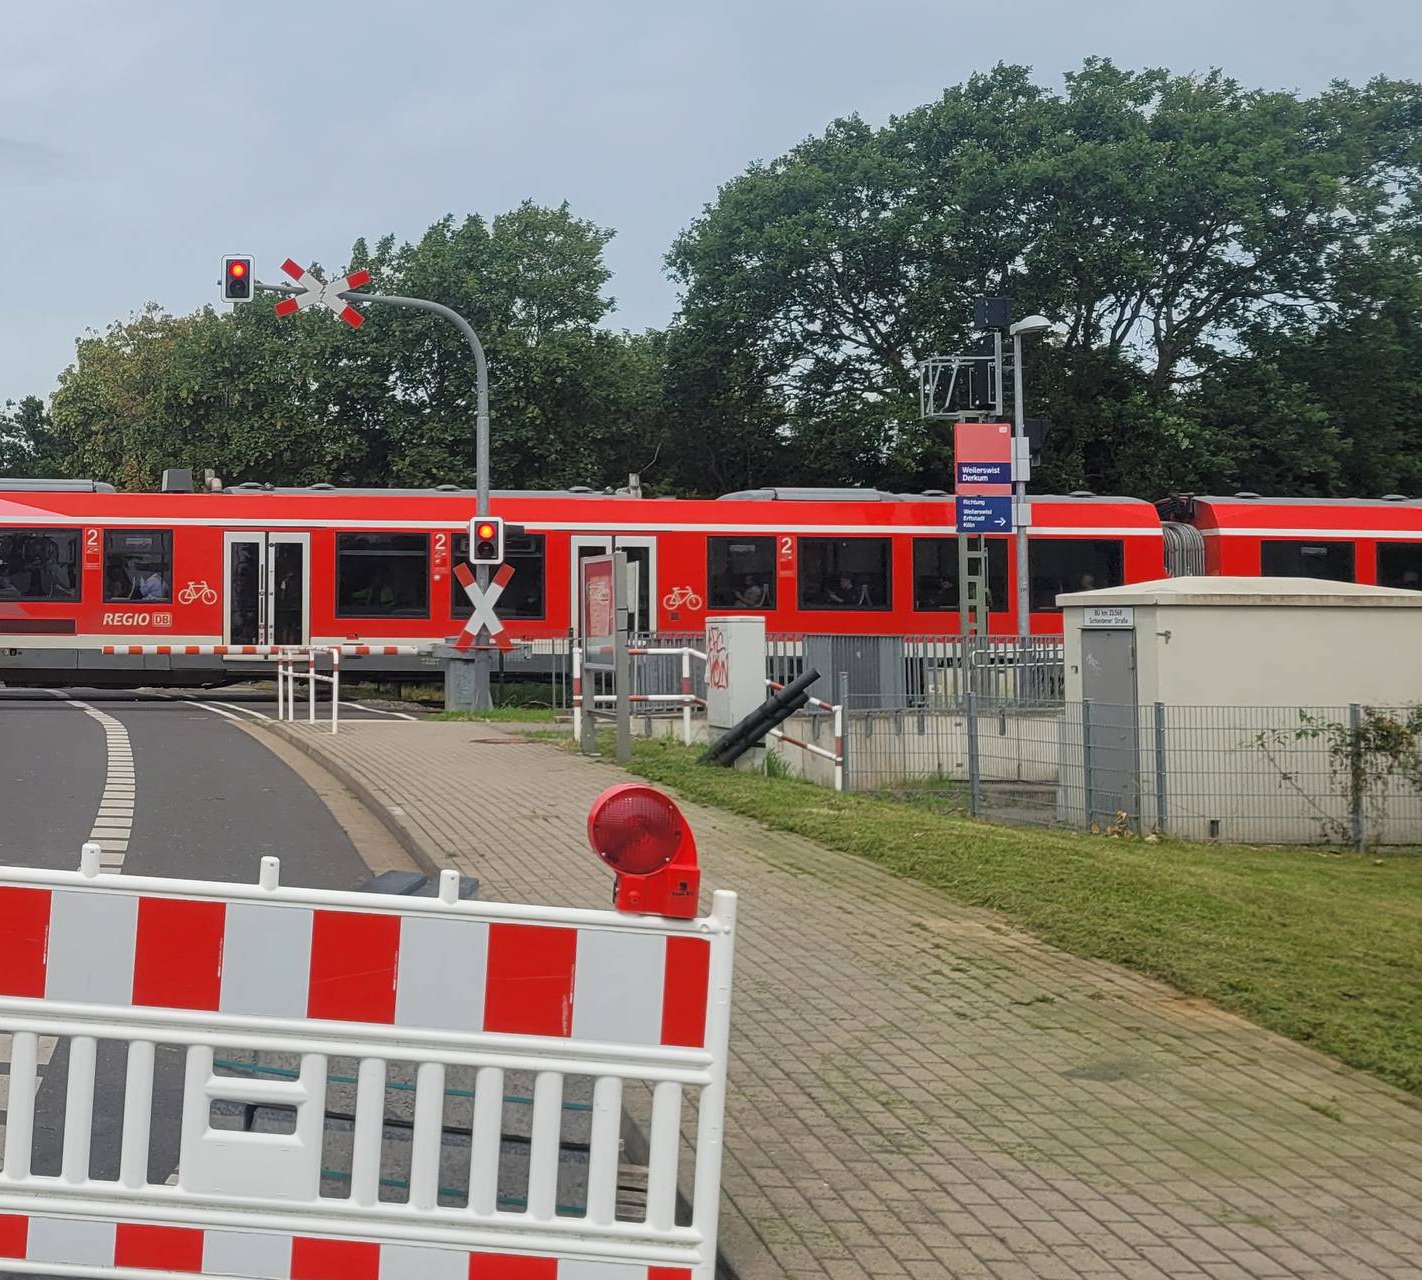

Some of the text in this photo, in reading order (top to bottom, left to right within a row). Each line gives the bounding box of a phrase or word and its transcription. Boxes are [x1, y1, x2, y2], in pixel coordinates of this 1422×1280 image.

[87, 529, 98, 546] 2
[435, 534, 446, 550] 2
[781, 537, 792, 553] 2
[102, 612, 172, 626] REGIO DB
